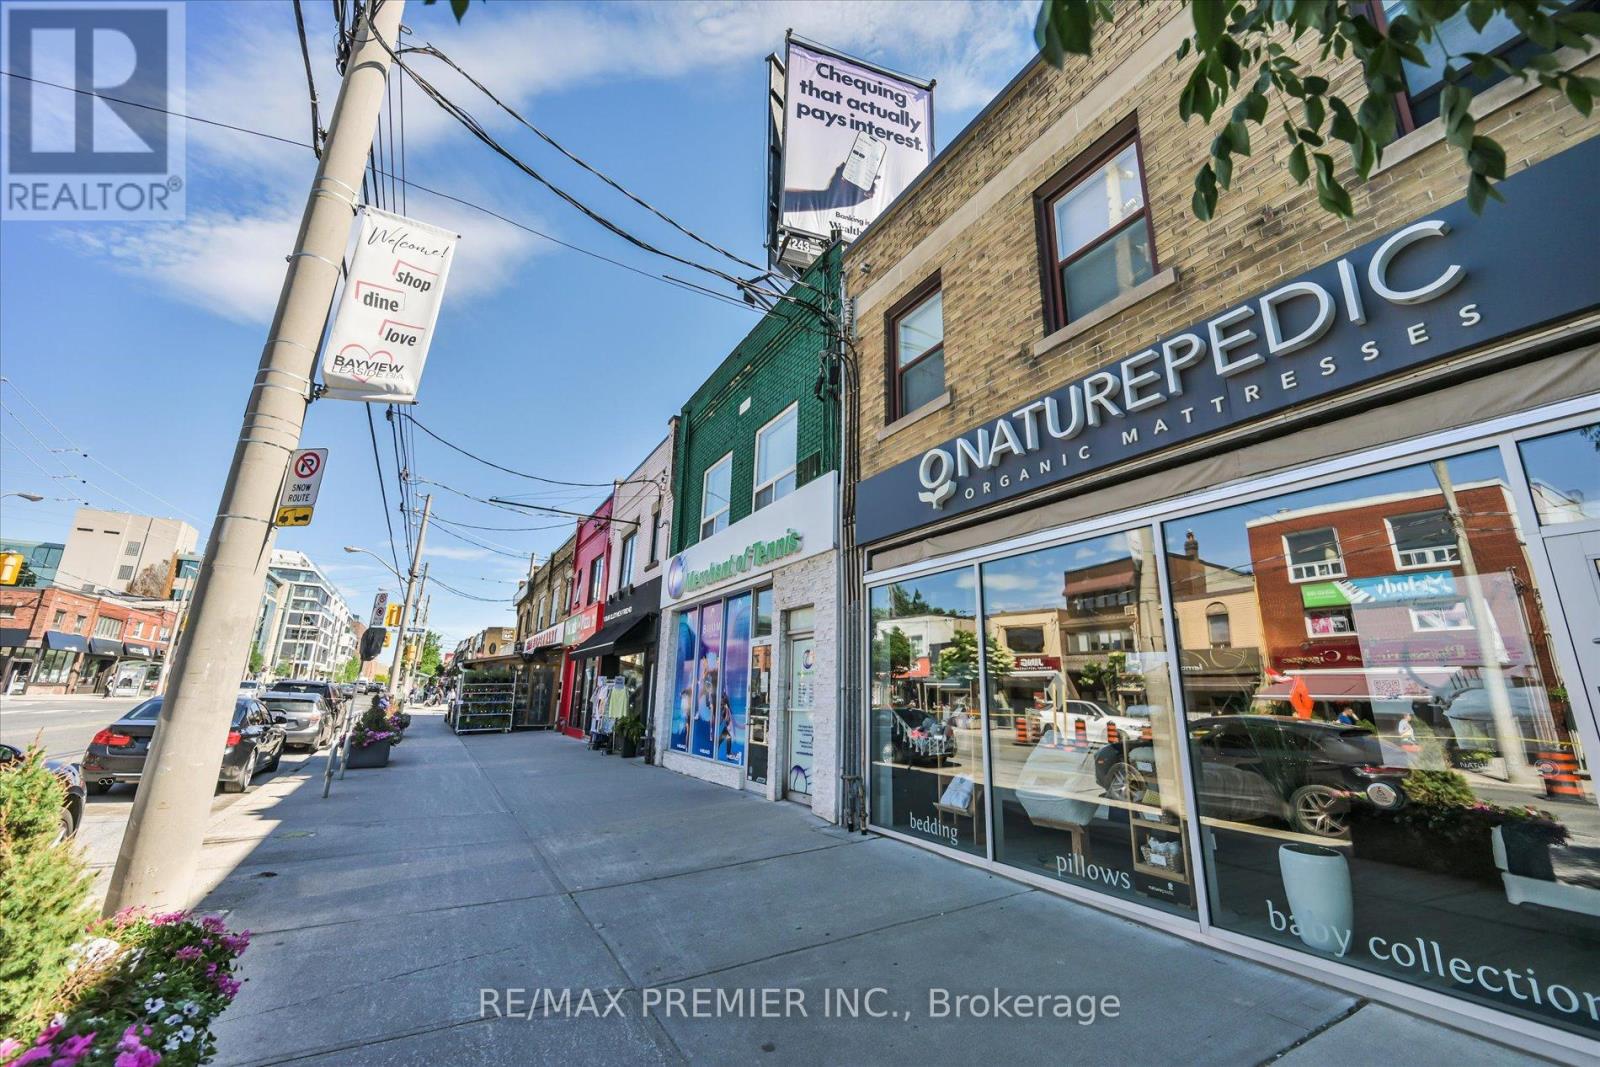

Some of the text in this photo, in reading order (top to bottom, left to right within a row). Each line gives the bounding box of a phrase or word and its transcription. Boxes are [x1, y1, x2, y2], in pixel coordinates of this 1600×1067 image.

[816, 62, 906, 108] Chequing
[799, 79, 921, 133] that actually
[796, 102, 924, 152] pays interest.
[835, 211, 864, 226] Banking
[368, 226, 450, 258] Welcome!
[396, 271, 431, 292] shop
[363, 292, 399, 312] dine
[384, 328, 417, 346] love
[957, 219, 1467, 477] NATUREPEDIC
[331, 364, 384, 378] LEASIDE
[334, 355, 404, 373] BAYVIEW
[964, 303, 1482, 501] ORGANIC MATTRESSES
[287, 493, 311, 502] ROUTE
[291, 483, 313, 492] SNOW
[685, 528, 803, 592] Merchant of Tennis
[909, 811, 959, 845] bedding
[1056, 848, 1132, 890] pillows
[1265, 899, 1352, 957] baby
